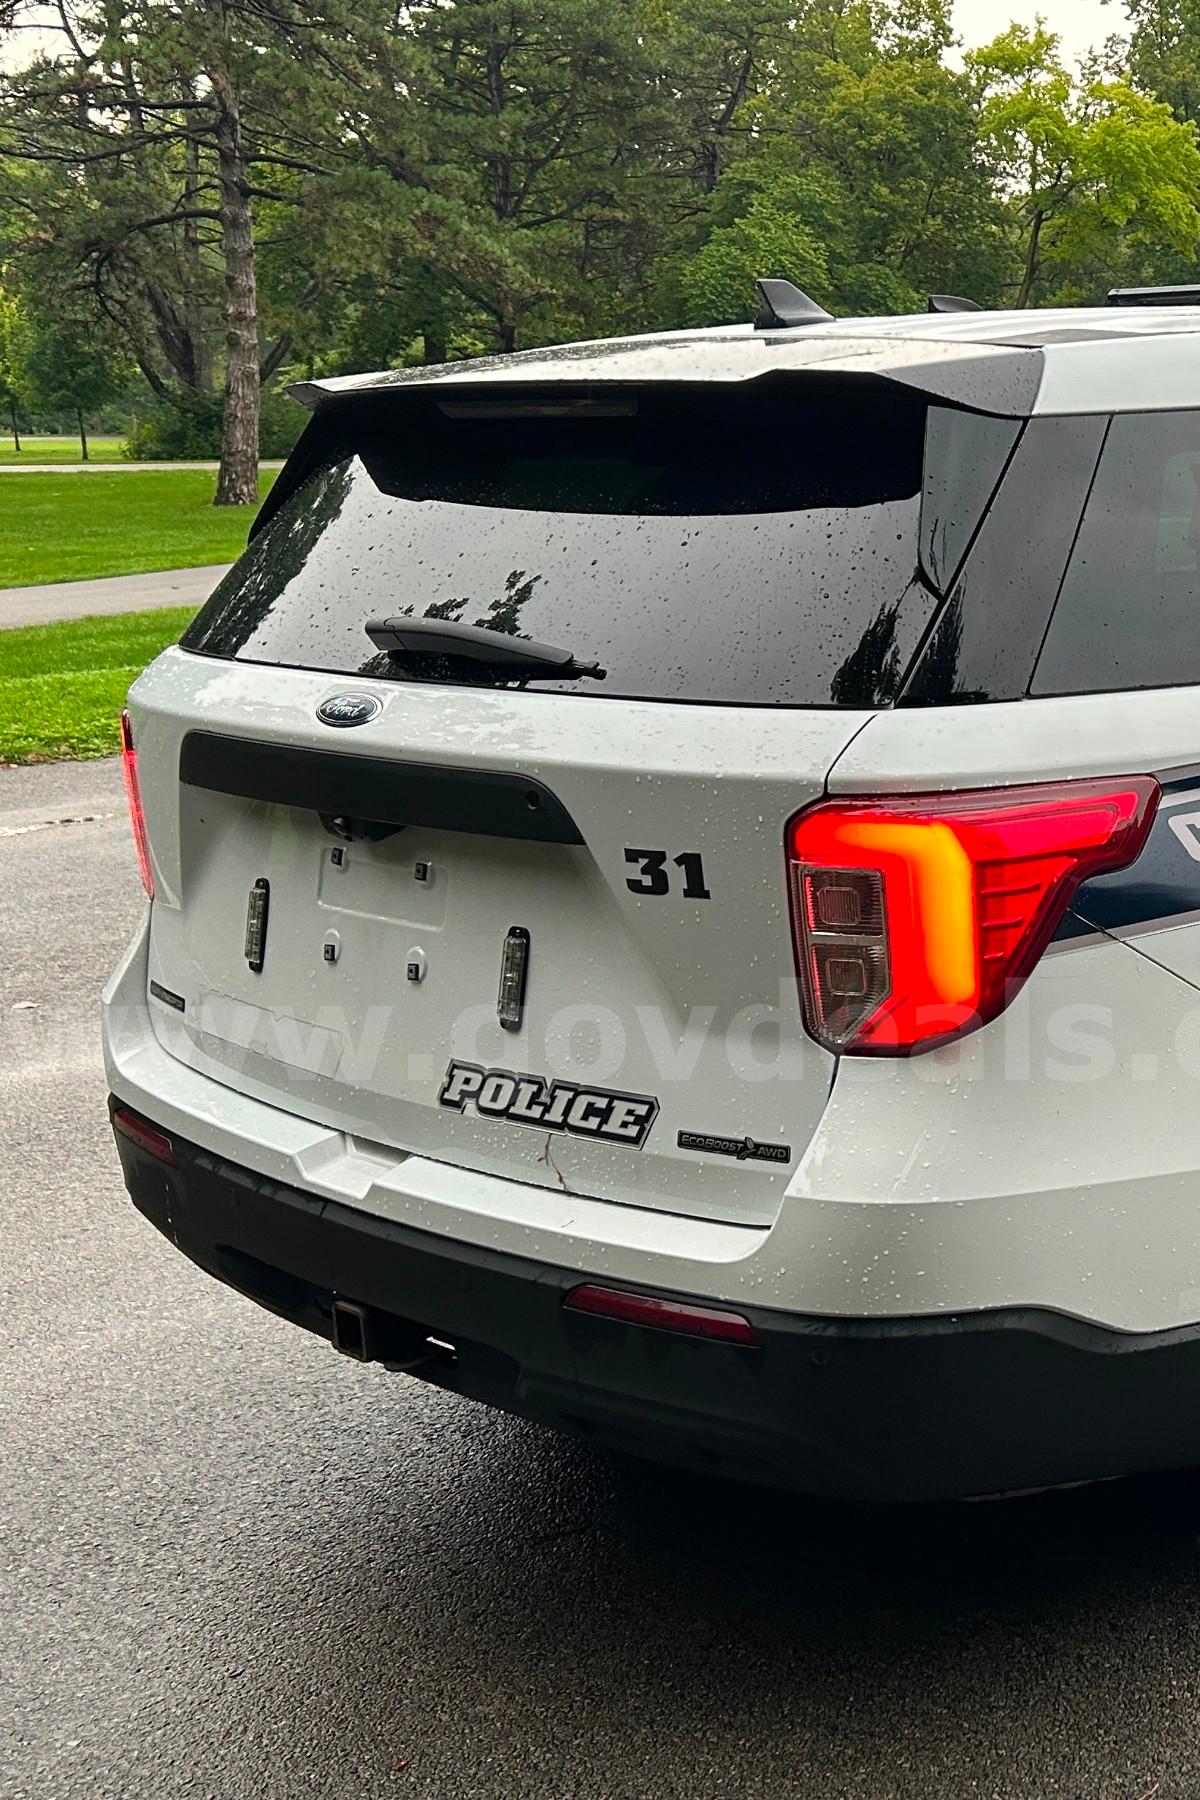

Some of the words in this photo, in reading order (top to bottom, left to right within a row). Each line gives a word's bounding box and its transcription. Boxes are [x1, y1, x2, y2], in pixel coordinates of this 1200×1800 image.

[623, 847, 711, 900] 31
[442, 1067, 651, 1139] POLICE
[757, 1145, 787, 1159] AWD
